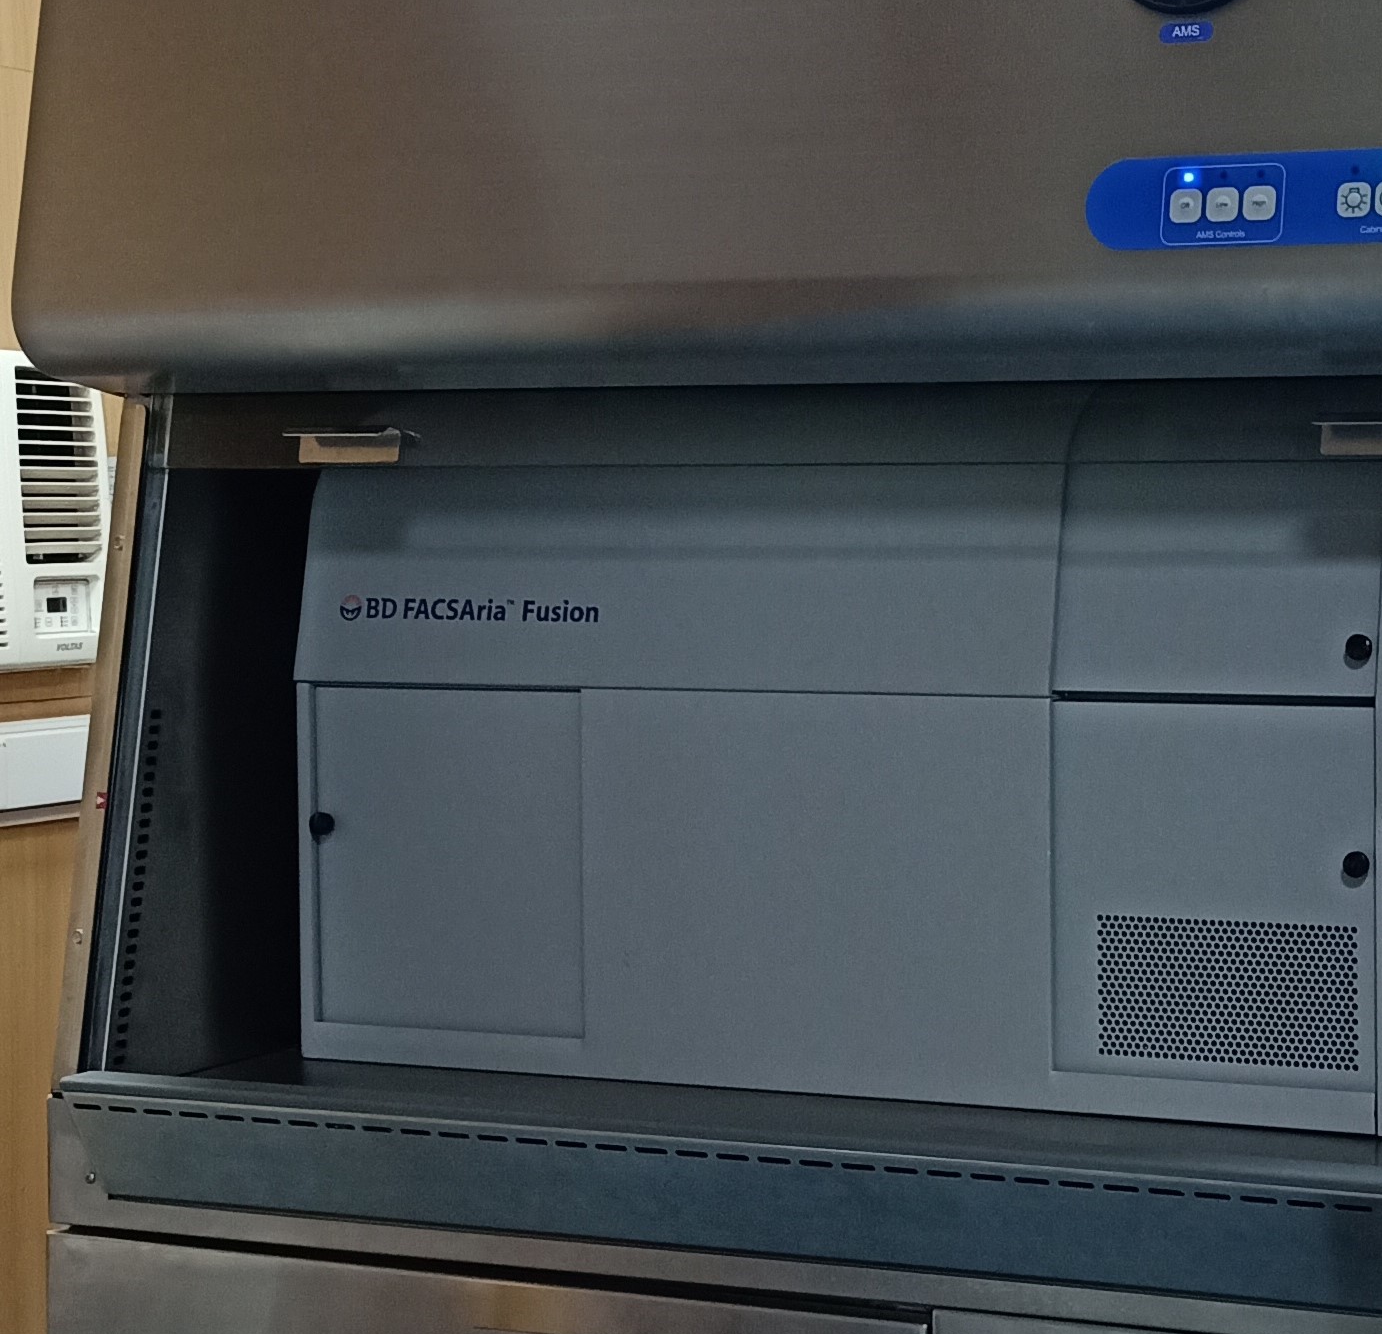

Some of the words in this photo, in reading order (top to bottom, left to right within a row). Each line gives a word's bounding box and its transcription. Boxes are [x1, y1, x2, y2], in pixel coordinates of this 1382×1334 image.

[1171, 24, 1200, 38] AMS
[1195, 230, 1214, 239] AMS
[366, 597, 398, 619] BD
[521, 599, 599, 623] Fusion
